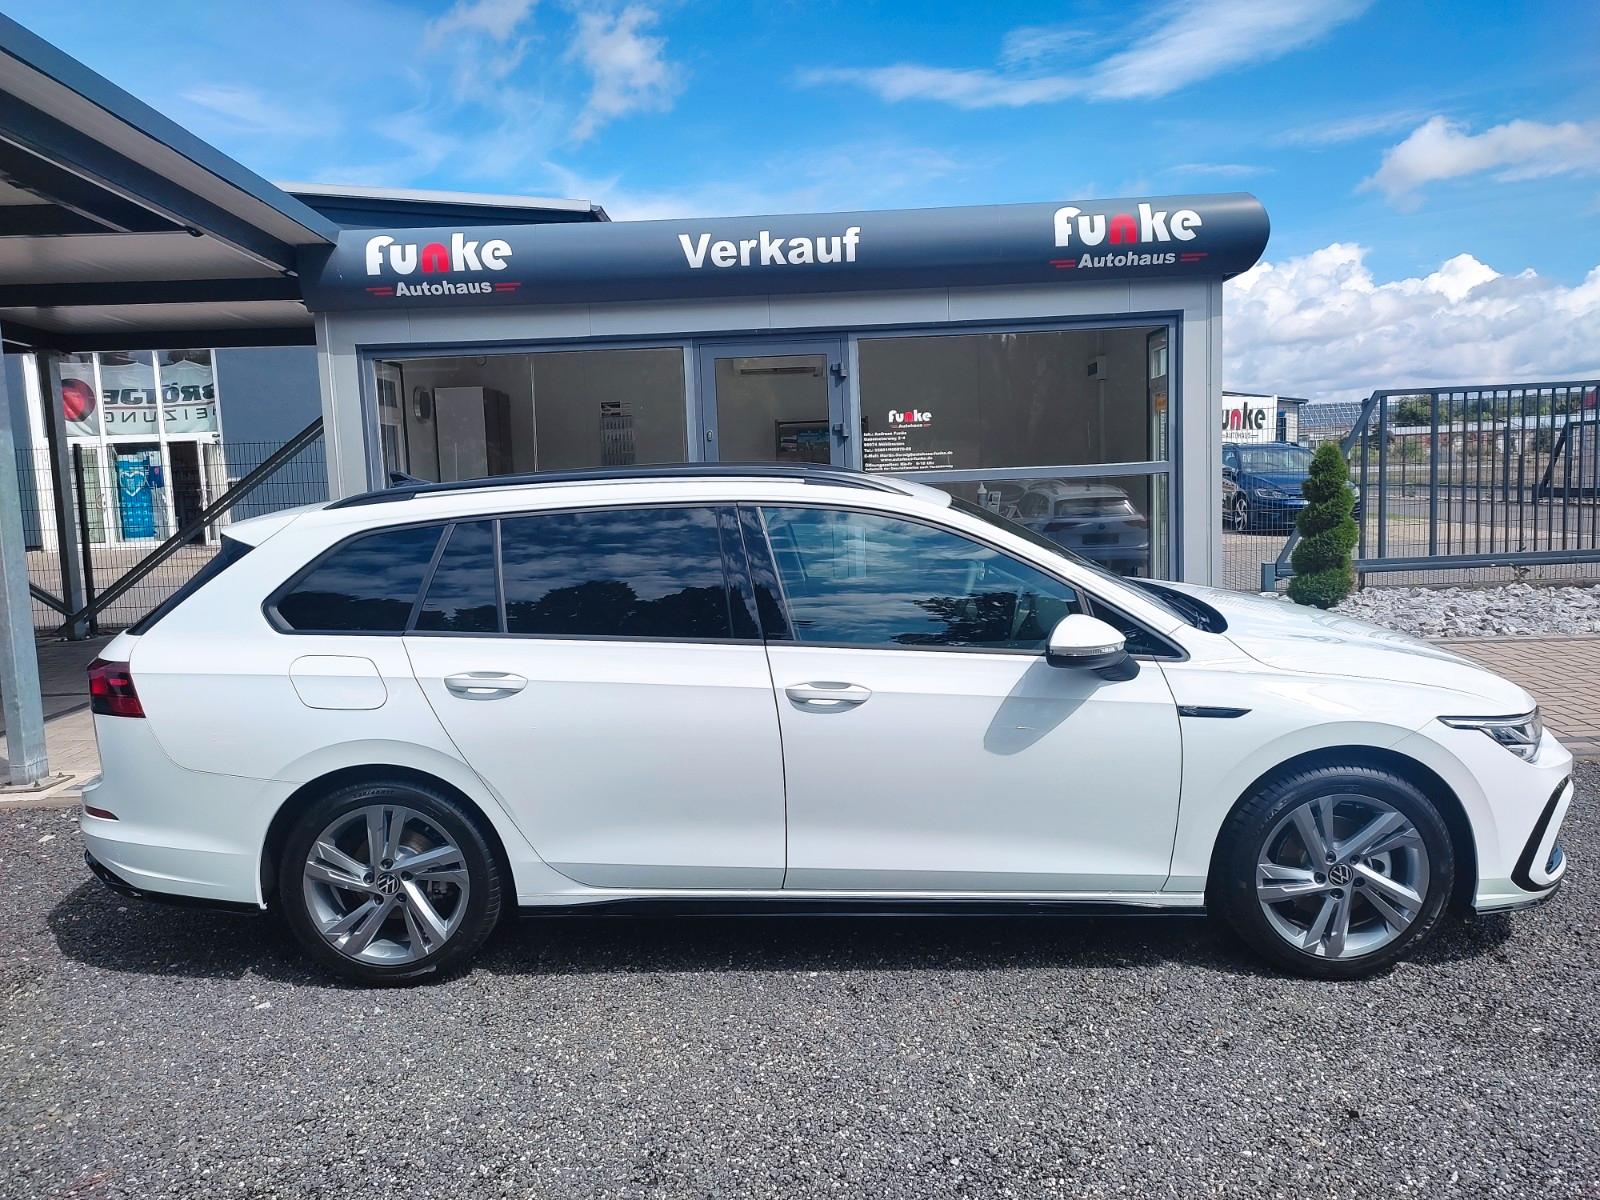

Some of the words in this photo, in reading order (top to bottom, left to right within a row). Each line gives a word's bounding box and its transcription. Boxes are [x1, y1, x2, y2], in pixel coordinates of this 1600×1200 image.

[1053, 203, 1203, 247] funke
[365, 232, 513, 276] funke
[678, 226, 862, 269] Verkauf
[1078, 251, 1176, 269] Autohaus
[396, 280, 493, 297] Autohaus
[889, 409, 932, 423] funke
[1222, 401, 1266, 430] unke
